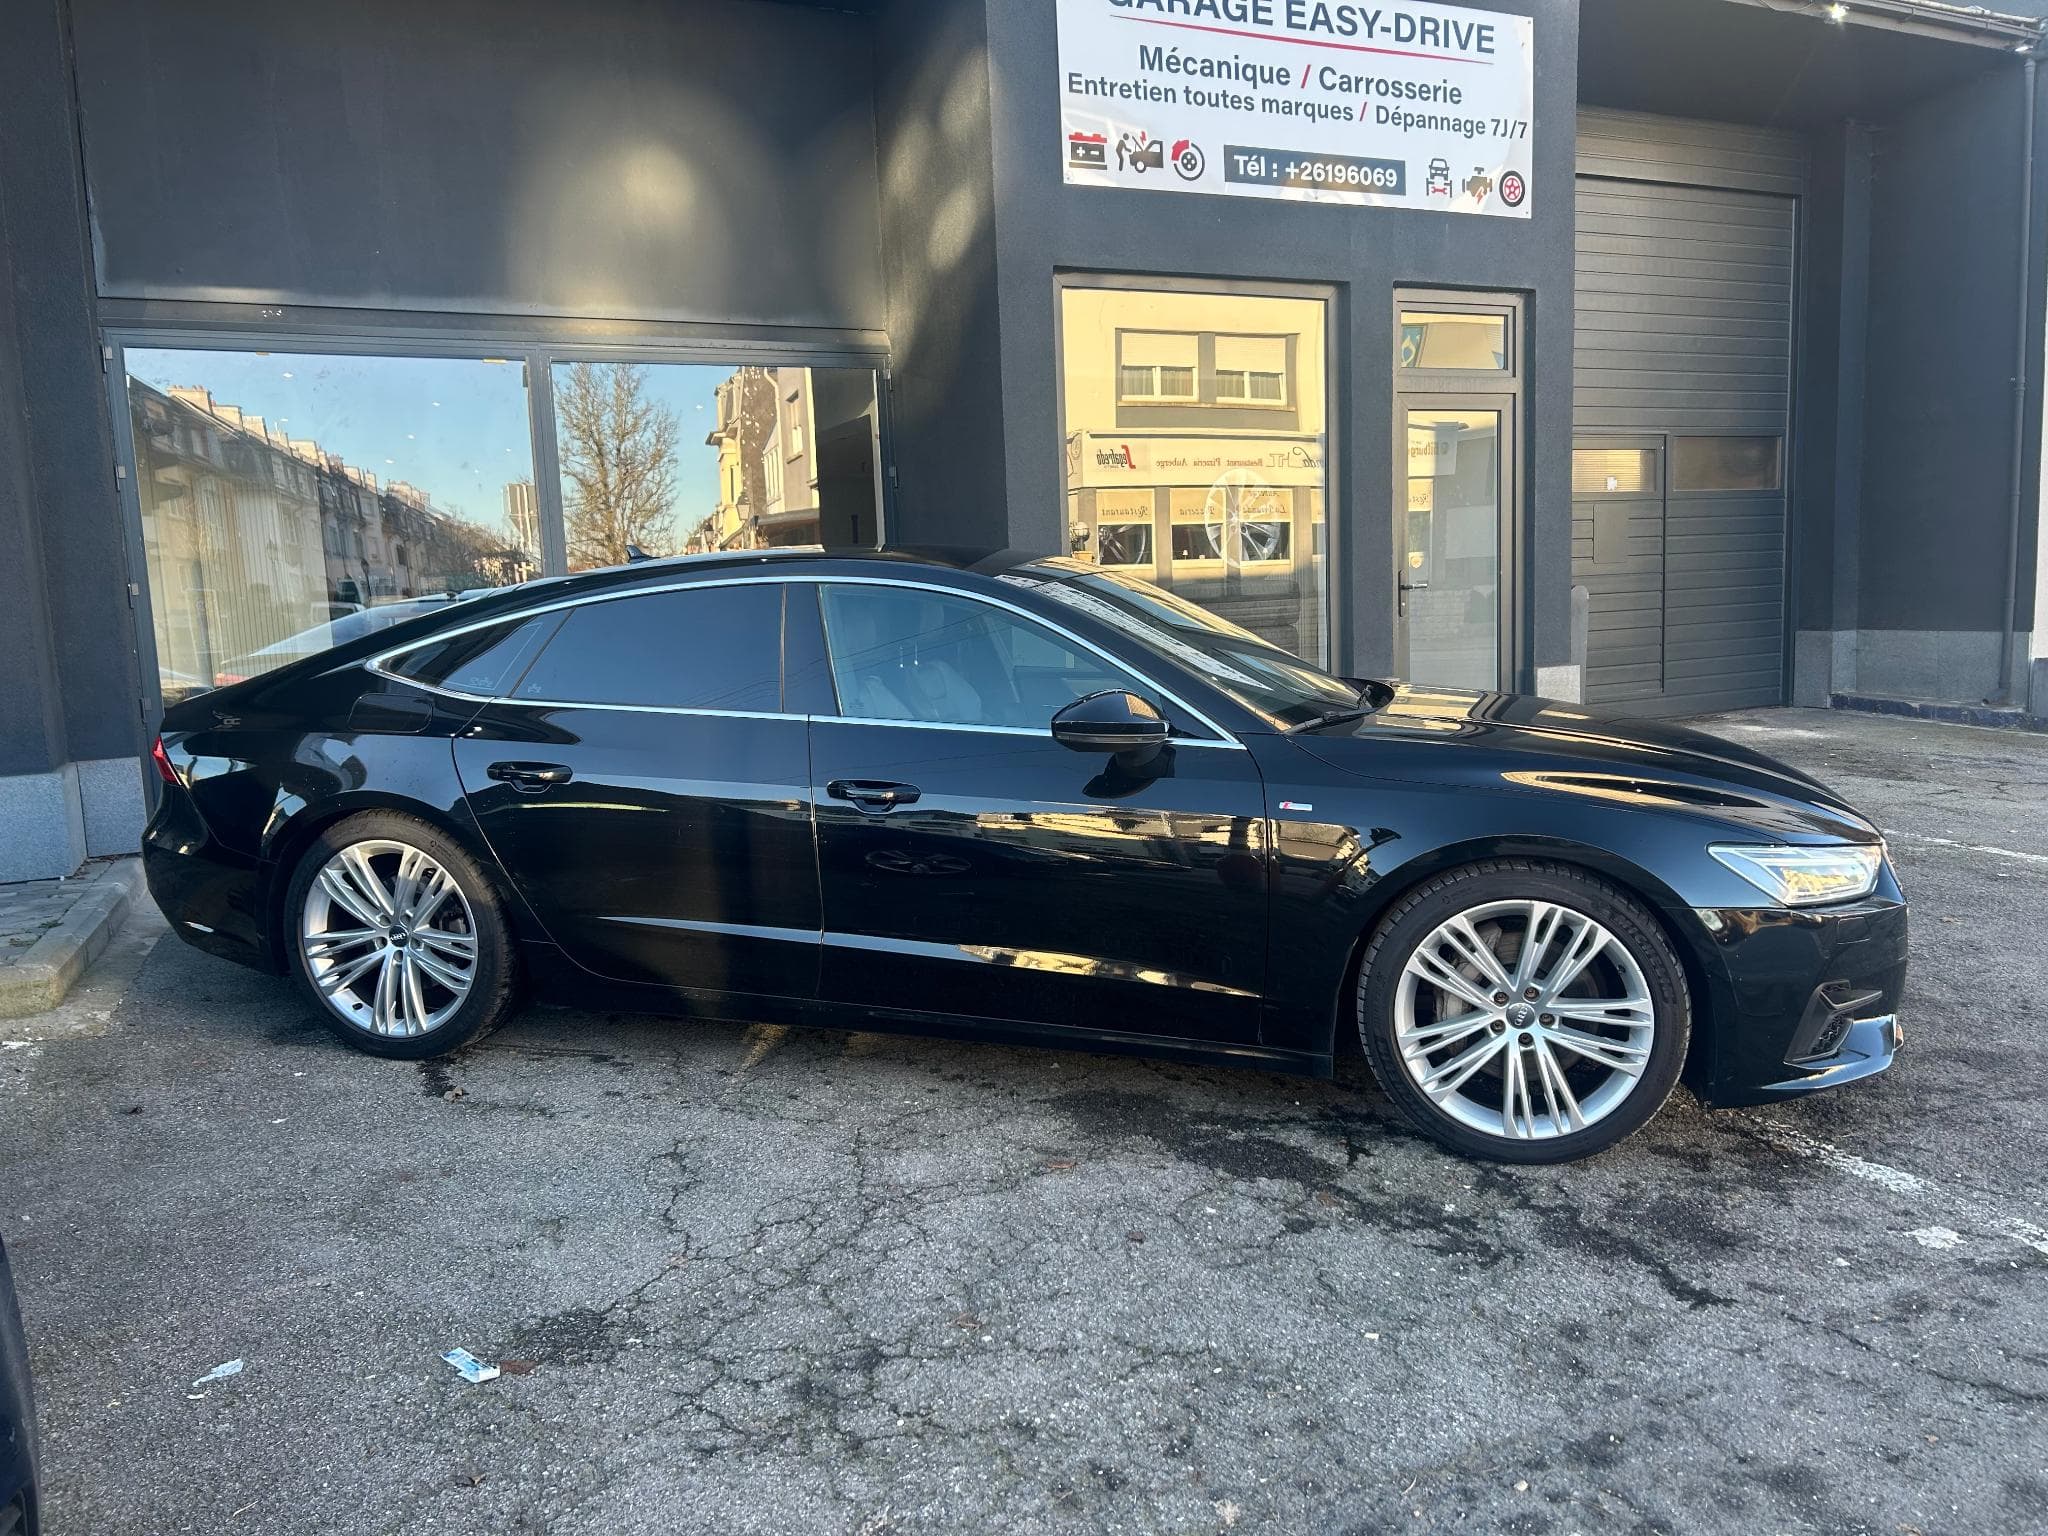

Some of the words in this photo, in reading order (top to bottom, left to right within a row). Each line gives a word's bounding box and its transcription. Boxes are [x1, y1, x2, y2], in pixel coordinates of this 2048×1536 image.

[1286, 0, 1495, 54] EASY-DRIVE
[1139, 44, 1291, 89] Mécanique
[1300, 63, 1312, 89] /
[1318, 66, 1463, 104] Carrosserie
[1068, 72, 1177, 103] Entretien
[1183, 85, 1255, 112] toutes
[1261, 96, 1354, 123] marques
[1359, 101, 1368, 122] /
[1376, 104, 1486, 139] Dépannage
[1490, 118, 1528, 139] 7J/7
[1233, 154, 1265, 177] Tél
[1285, 160, 1398, 188] +26196069
